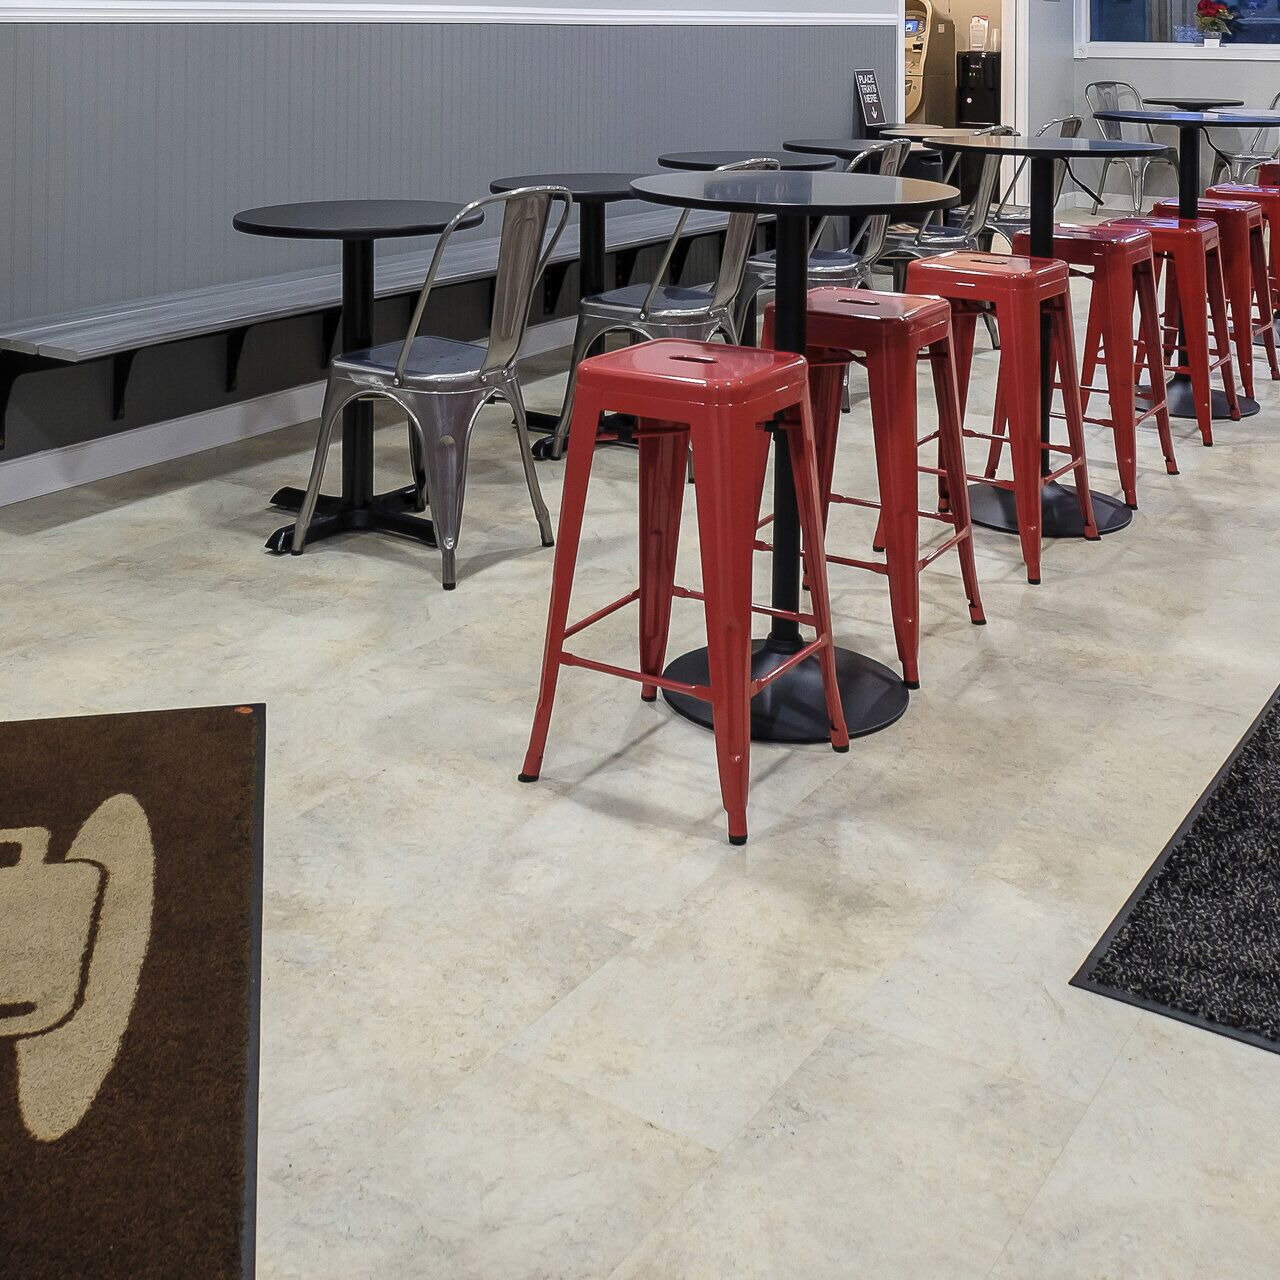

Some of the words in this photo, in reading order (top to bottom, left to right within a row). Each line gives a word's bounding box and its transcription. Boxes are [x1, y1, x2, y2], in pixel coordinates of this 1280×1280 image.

[857, 74, 876, 84] PLACE
[860, 84, 877, 94] TRAYS
[863, 93, 879, 103] HERE
